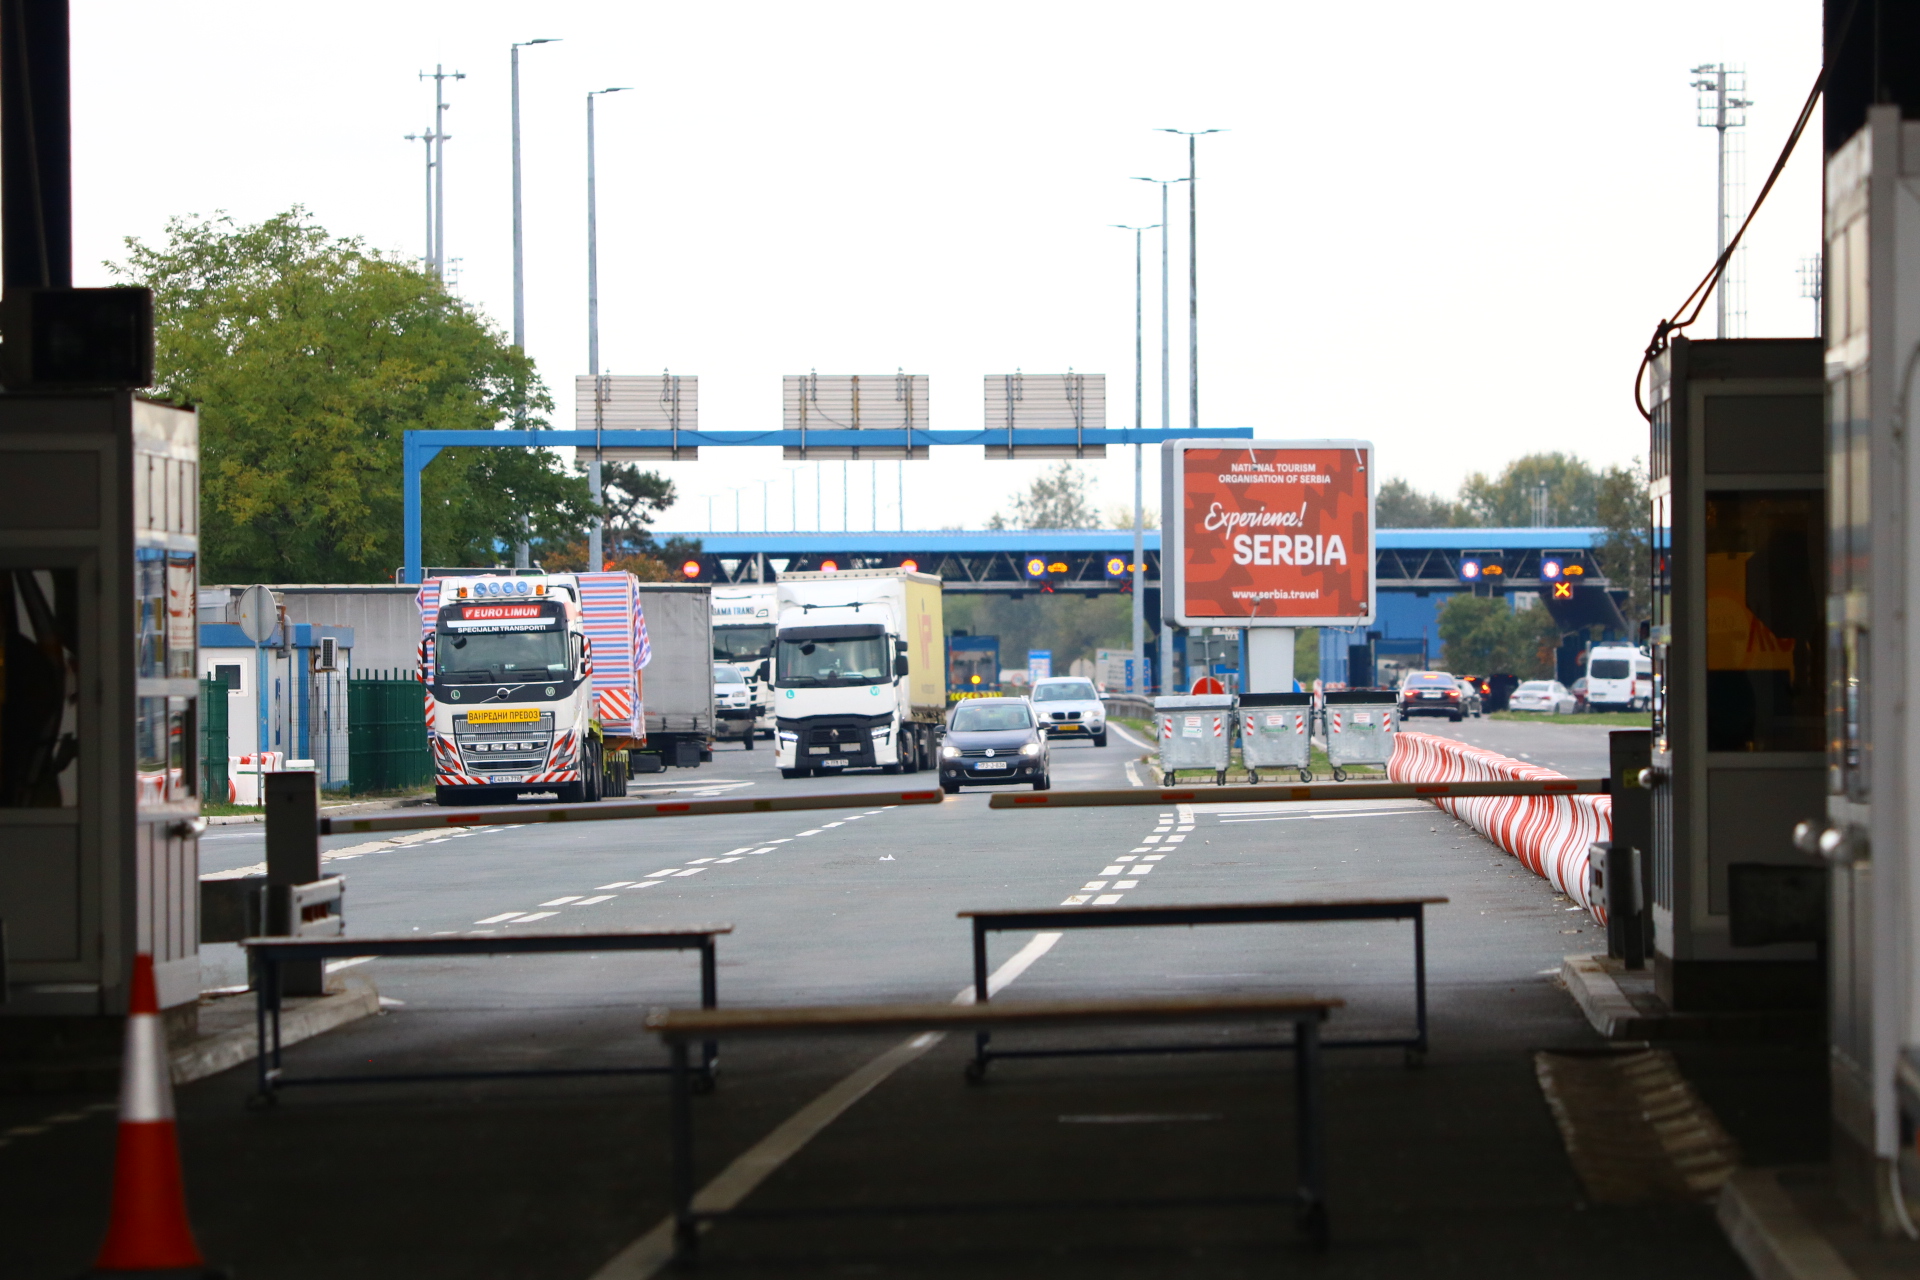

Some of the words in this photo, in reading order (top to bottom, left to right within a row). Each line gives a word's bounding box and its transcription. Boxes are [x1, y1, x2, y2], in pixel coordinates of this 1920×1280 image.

[1276, 463, 1316, 473] TOURISM
[1218, 474, 1284, 484] ORGANISATION
[1285, 474, 1298, 484] OF
[1300, 474, 1331, 484] SERBIA
[1204, 501, 1307, 540] Experience!
[1233, 534, 1347, 566] SERBIA
[1232, 588, 1319, 600] wwwserbia.travel
[473, 607, 502, 617] EURO
[504, 608, 538, 617] LIMUN
[733, 606, 755, 615] TRANS
[500, 625, 546, 633] TRANSPORTI
[468, 711, 508, 722] ВАНРЕДНИ
[509, 710, 539, 720] ПРЕВОЗ
